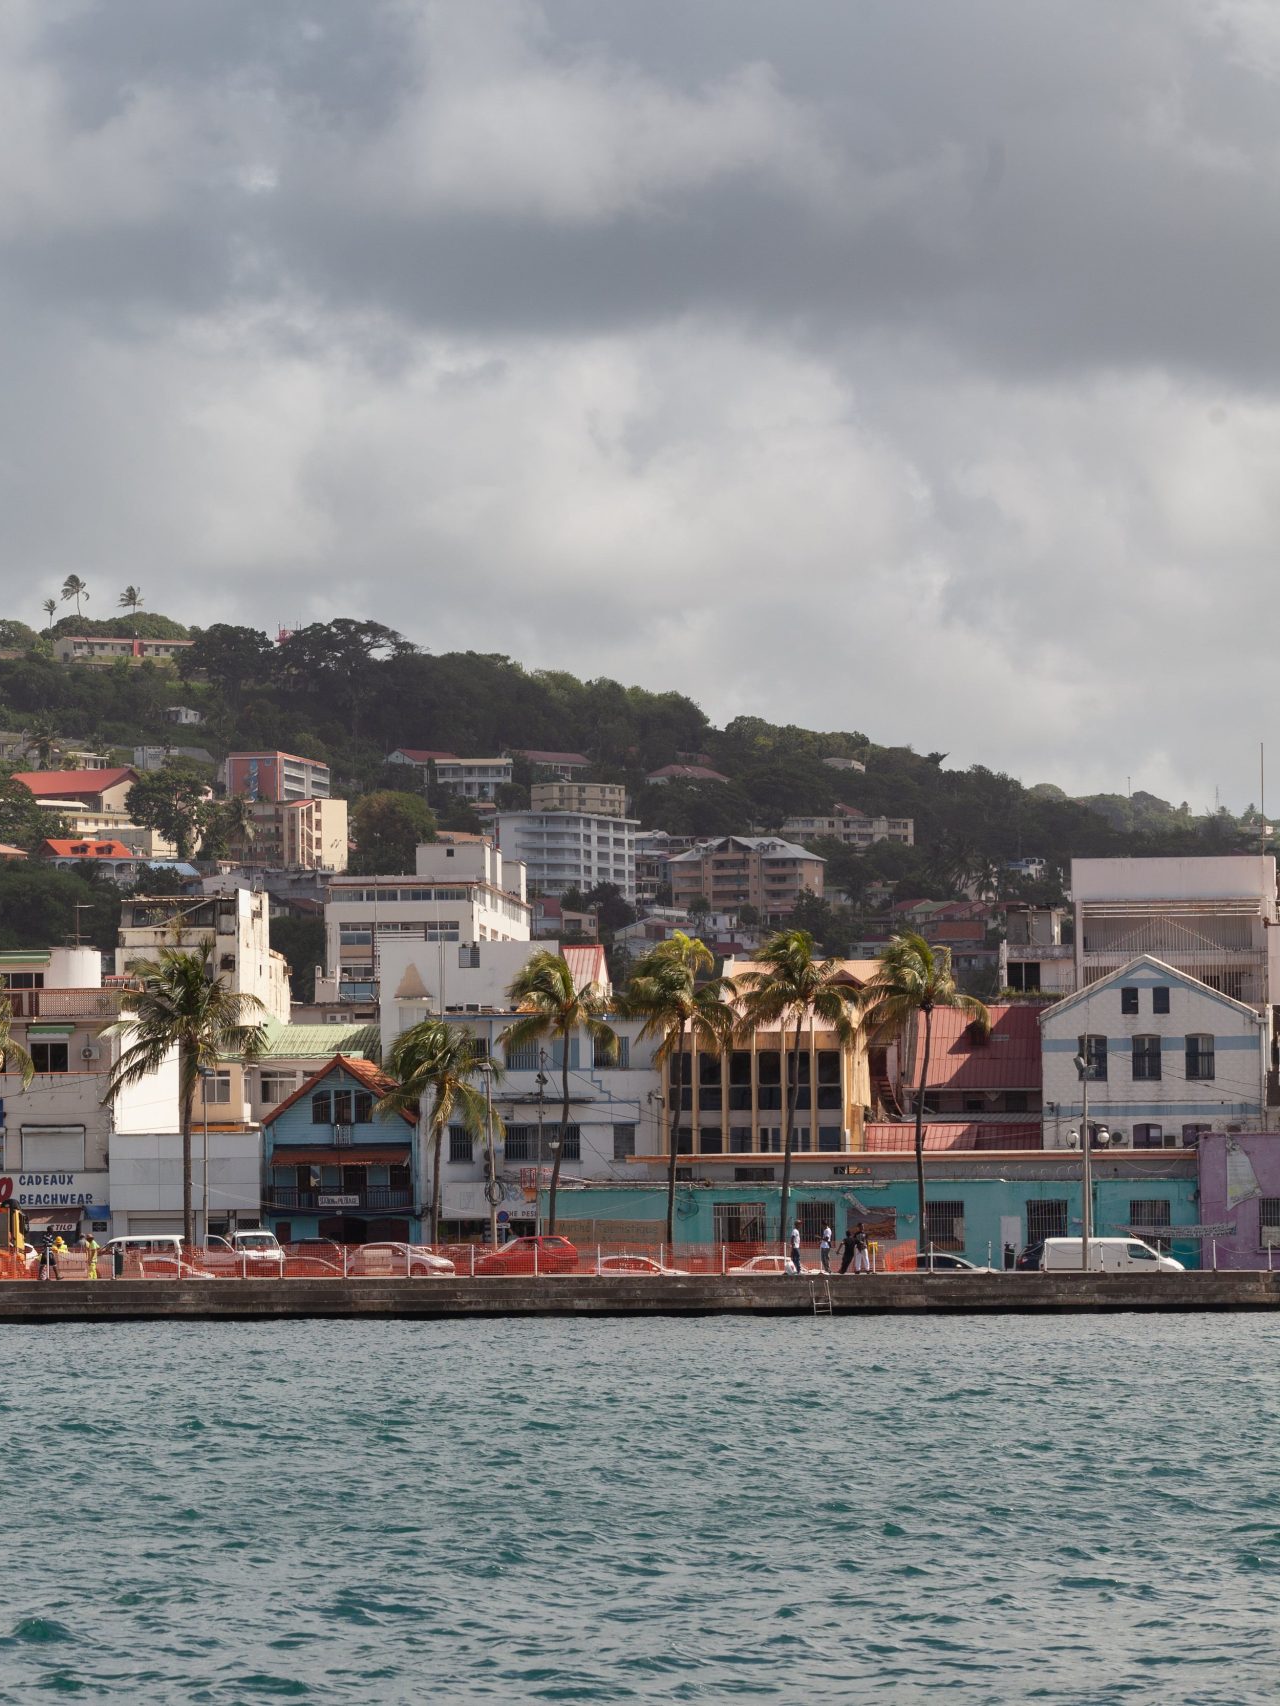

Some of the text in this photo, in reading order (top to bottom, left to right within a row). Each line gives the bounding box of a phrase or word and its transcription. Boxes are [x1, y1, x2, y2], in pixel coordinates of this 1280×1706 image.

[19, 1174, 74, 1186] CADEAUX
[20, 1193, 93, 1205] BEACHWEAR
[55, 1223, 73, 1231] TILO
